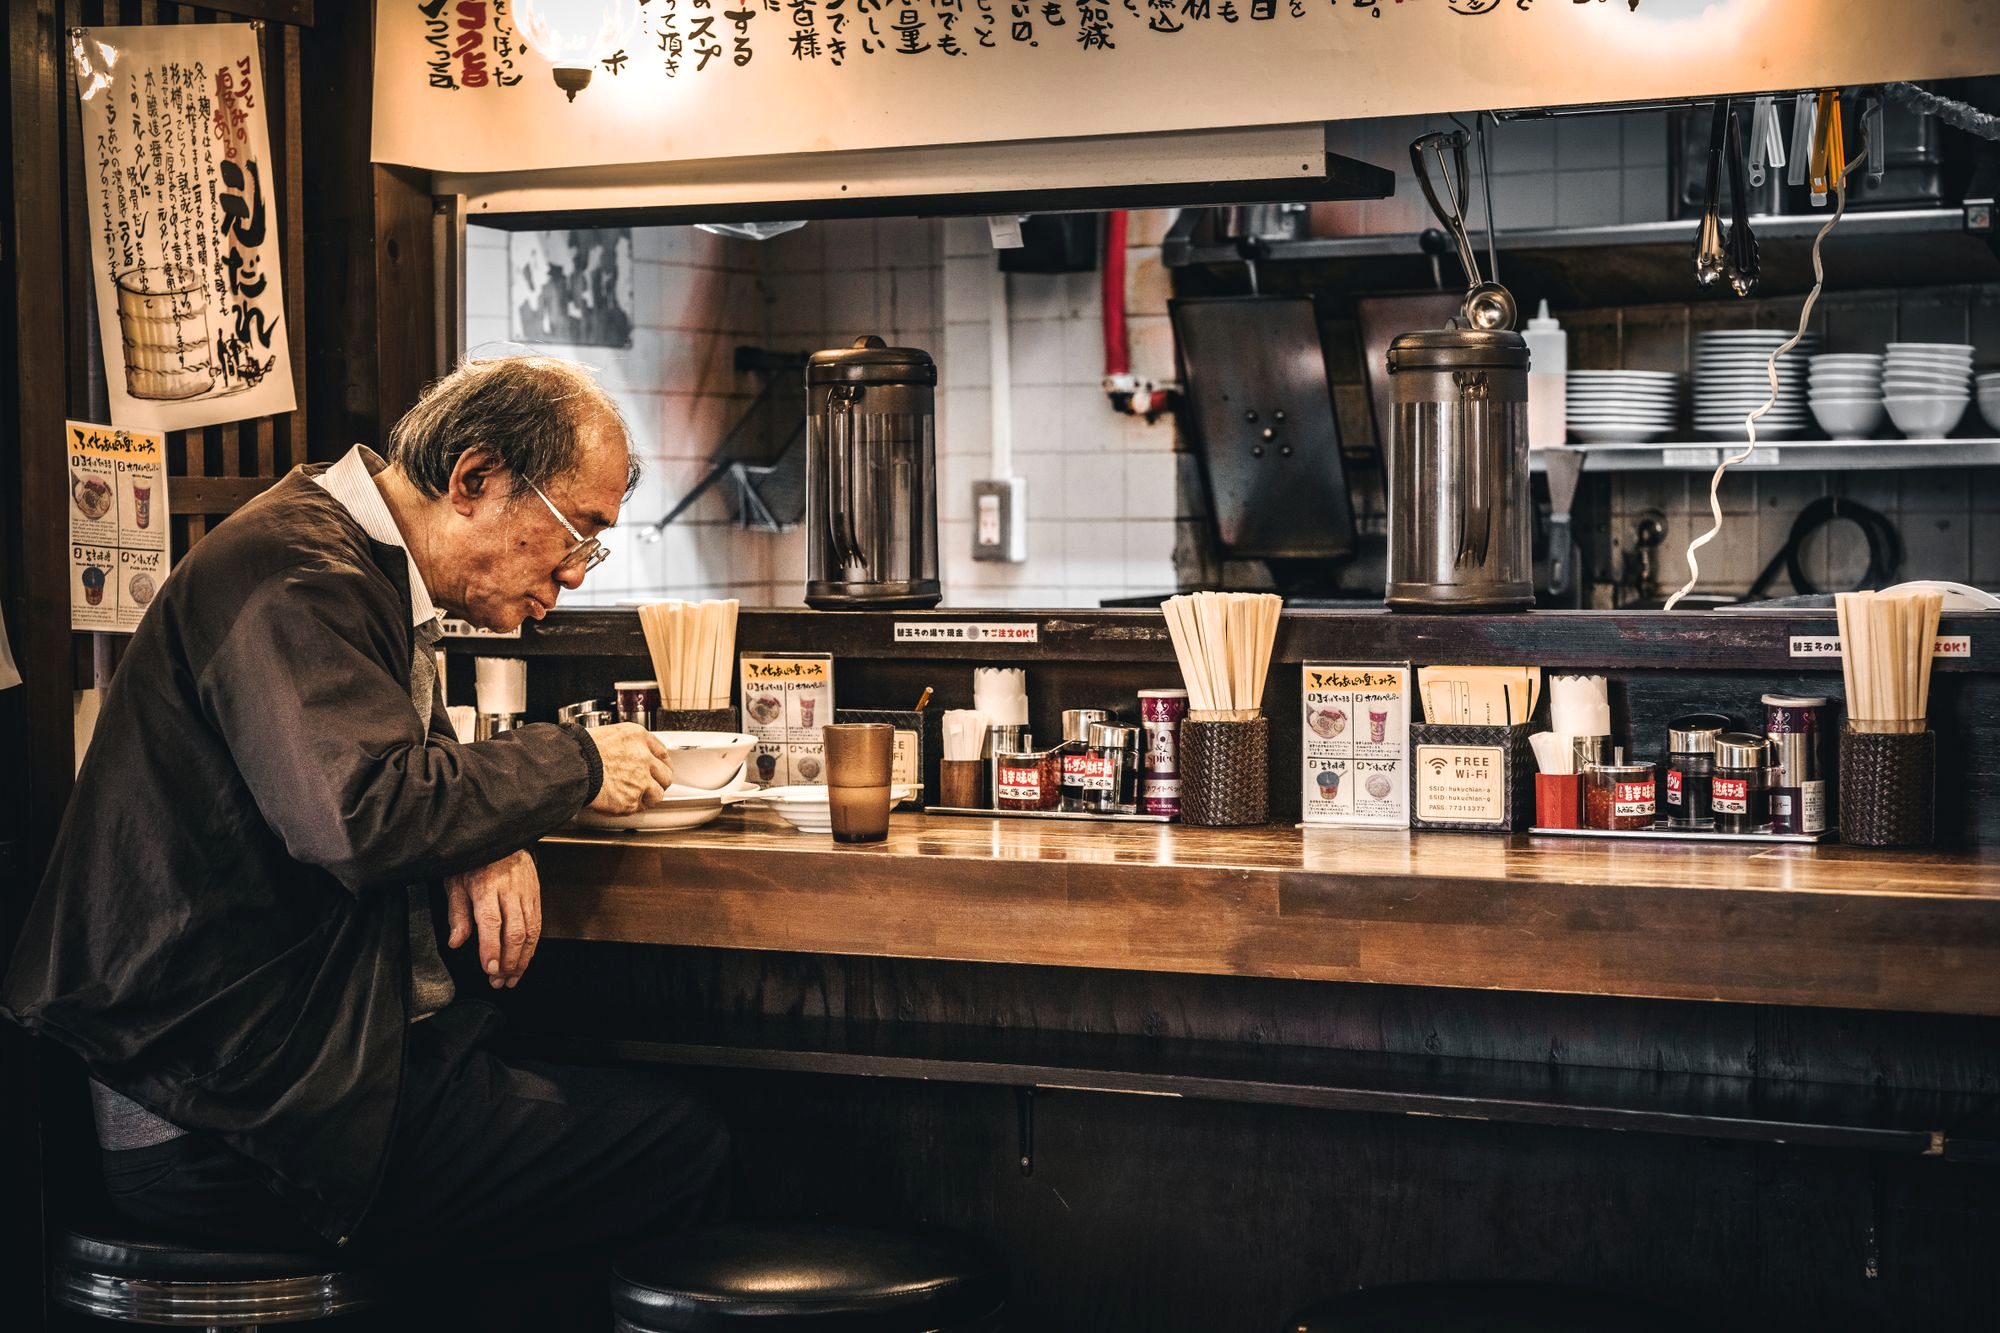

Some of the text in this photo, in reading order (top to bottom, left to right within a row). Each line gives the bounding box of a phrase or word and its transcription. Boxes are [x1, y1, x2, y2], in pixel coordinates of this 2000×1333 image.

[723, 7, 756, 67] する
[1076, 0, 1116, 51] 加減
[219, 159, 280, 349] 元だれ
[1455, 757, 1489, 766] FREE
[1456, 769, 1488, 779] Wi-Fi
